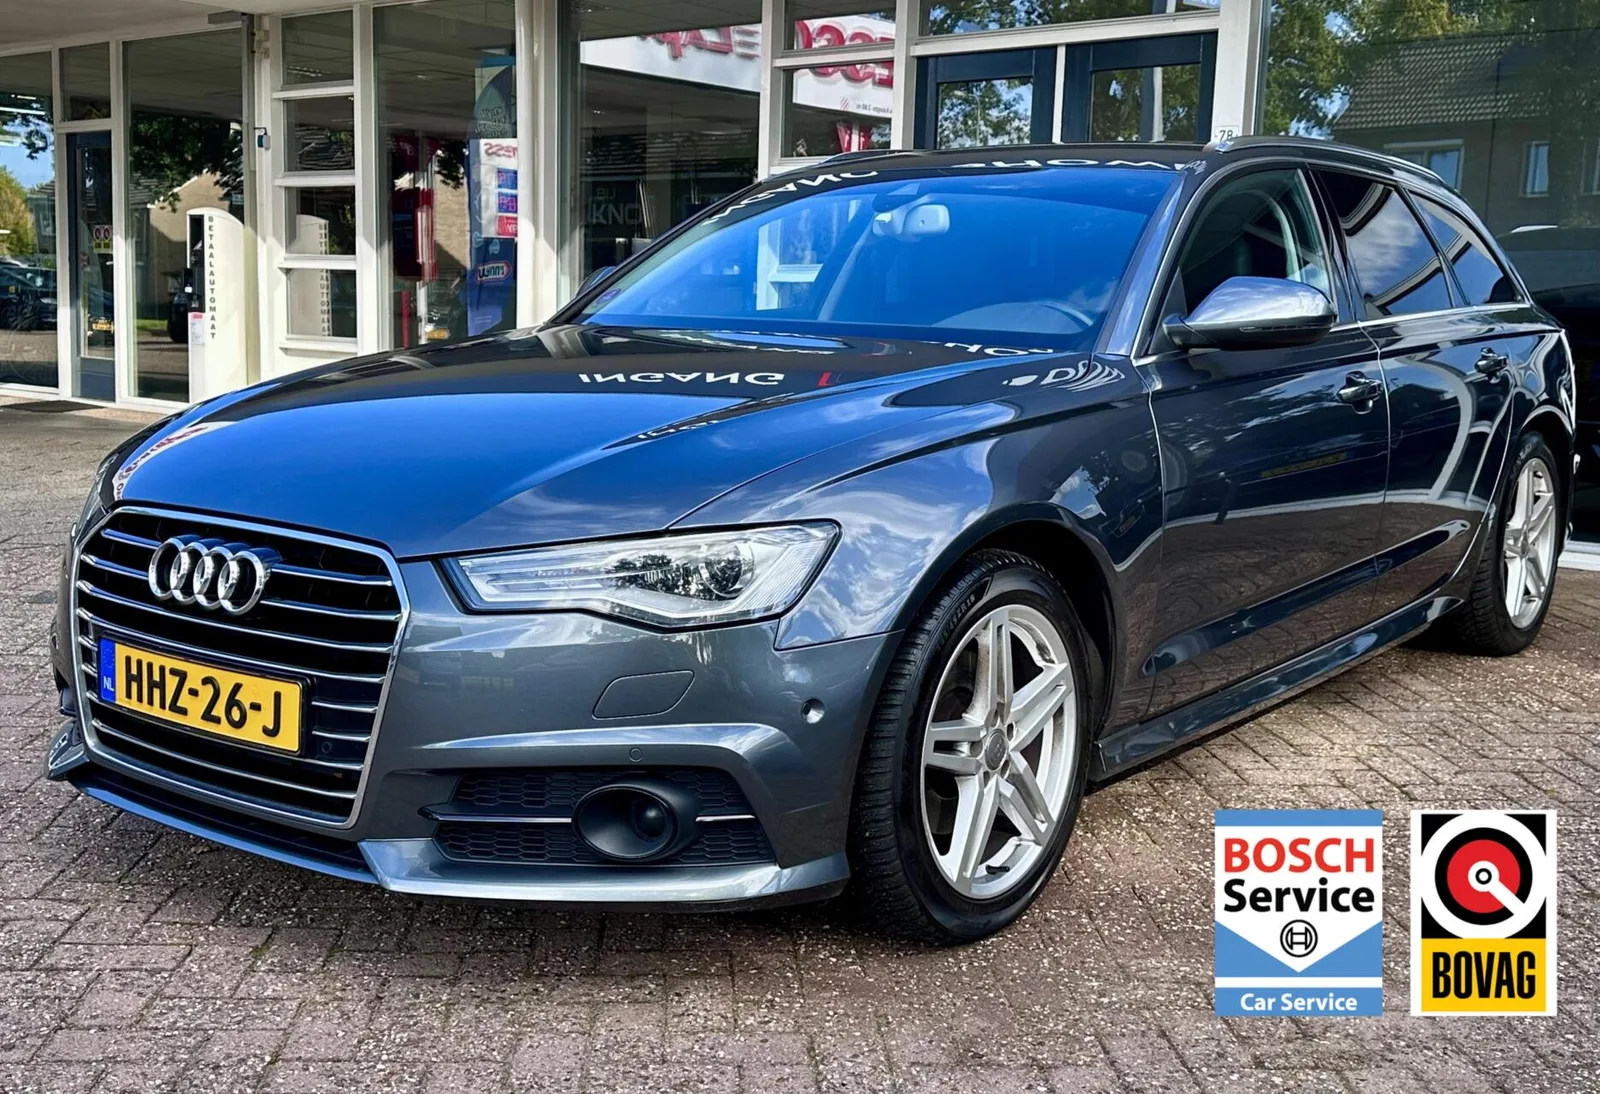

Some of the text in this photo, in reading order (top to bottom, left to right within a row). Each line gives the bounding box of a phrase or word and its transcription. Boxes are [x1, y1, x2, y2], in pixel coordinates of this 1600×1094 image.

[1219, 129, 1233, 142] 78
[208, 215, 217, 339] BETAALAUTOMAAT
[103, 676, 115, 692] NL
[125, 655, 281, 738] HHZ-26-J
